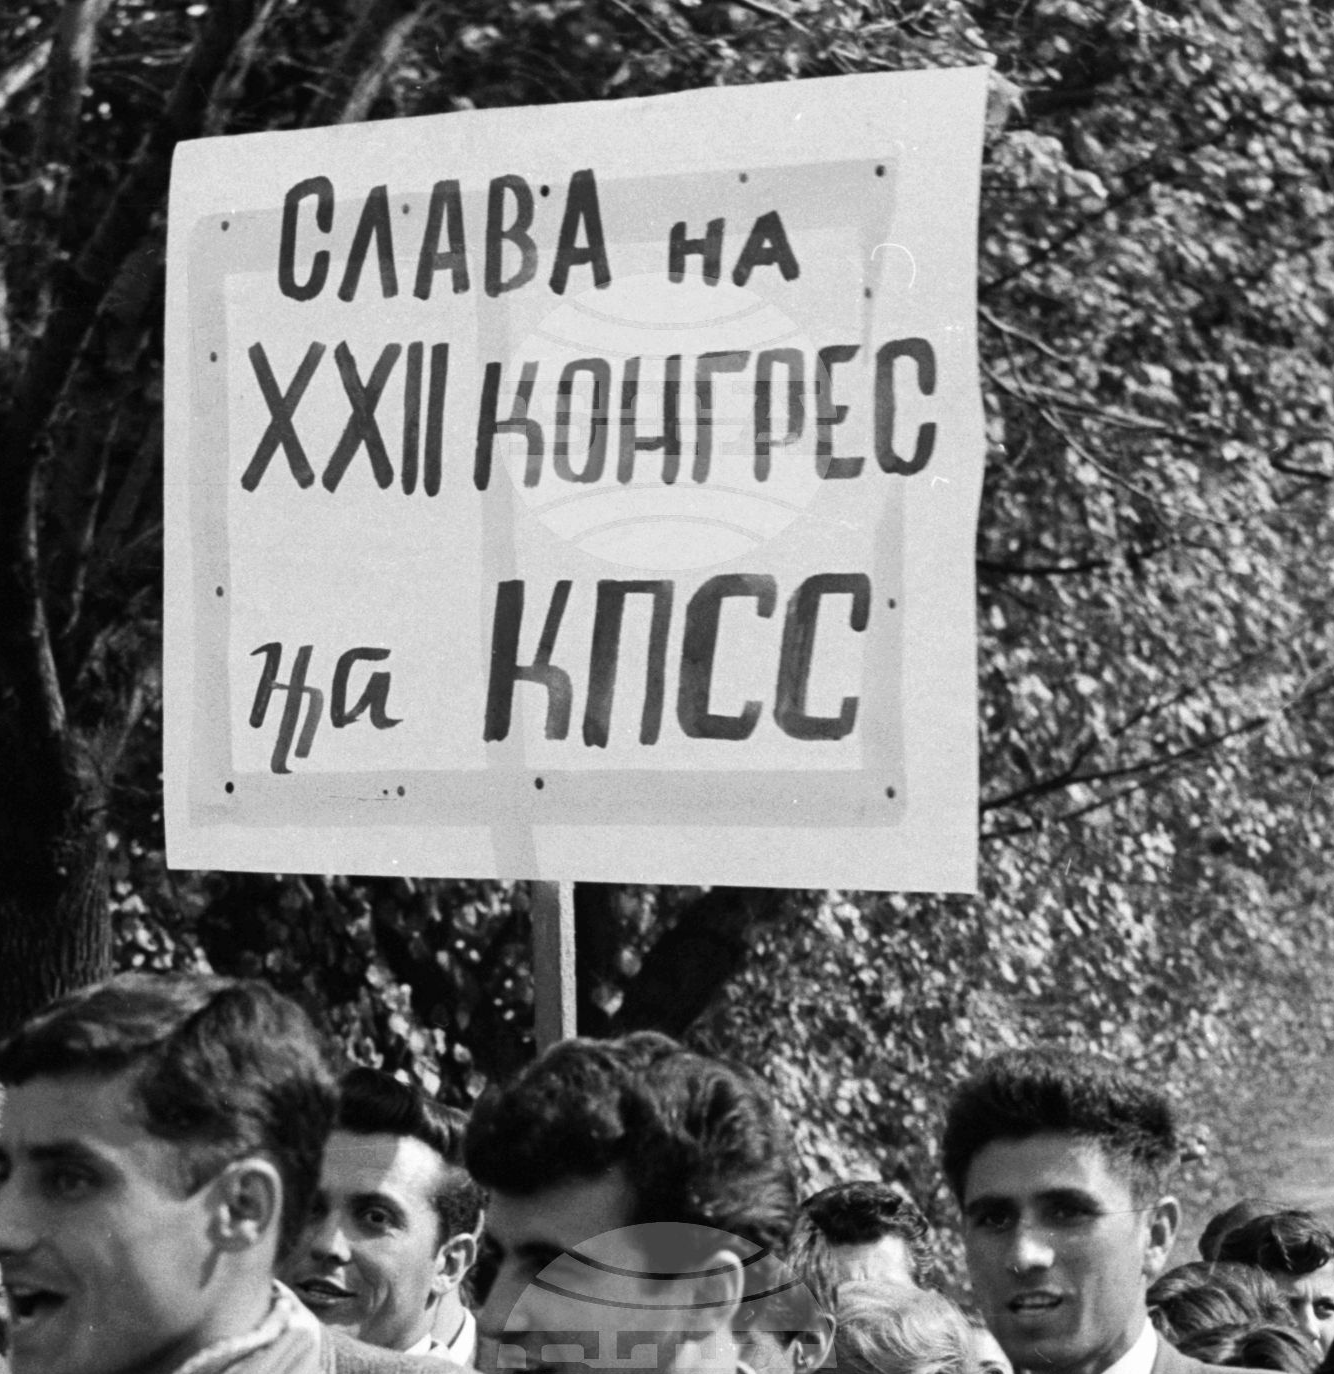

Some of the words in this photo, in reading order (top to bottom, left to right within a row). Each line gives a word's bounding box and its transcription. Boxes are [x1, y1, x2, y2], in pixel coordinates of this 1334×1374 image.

[278, 169, 611, 302] СЛАВА
[241, 341, 449, 497] XXII
[473, 338, 937, 491] КОНГРЕС
[483, 573, 871, 748] КПСС
